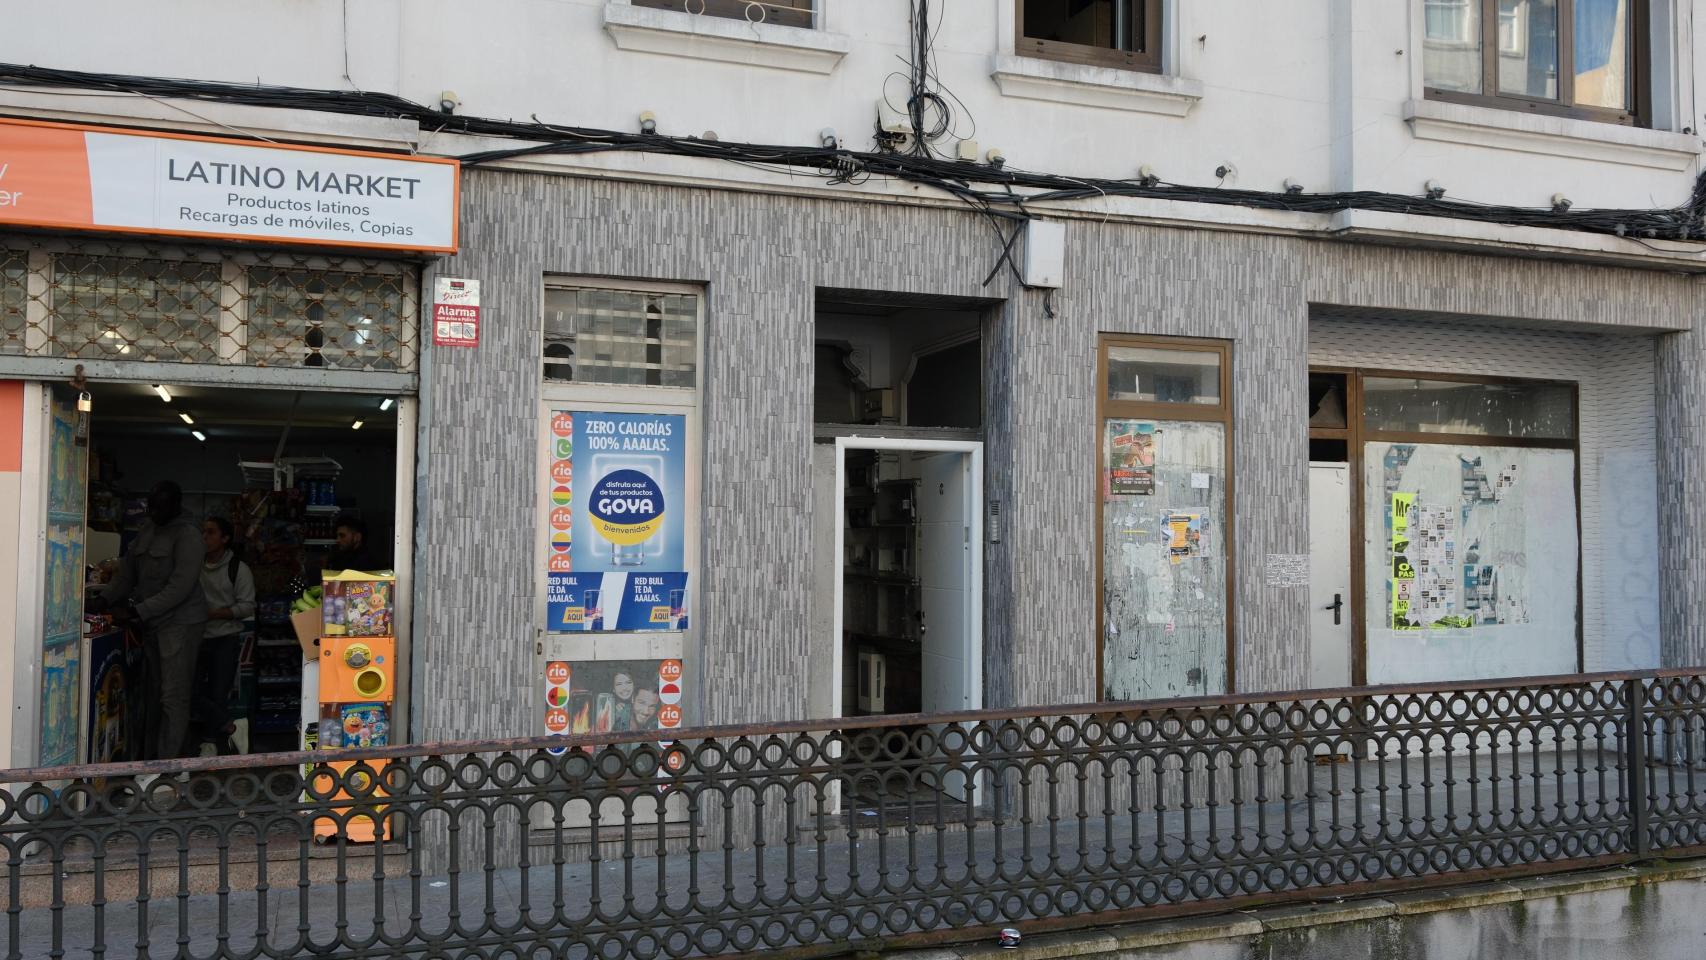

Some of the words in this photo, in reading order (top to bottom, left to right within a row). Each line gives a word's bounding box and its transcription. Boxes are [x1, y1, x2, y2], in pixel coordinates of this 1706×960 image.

[168, 158, 286, 190] LATINO
[296, 169, 421, 200] MARKET
[227, 193, 312, 212] Productos
[317, 199, 370, 216] latinos
[179, 206, 258, 227] Recargas
[263, 213, 284, 228] de
[289, 216, 355, 234] móviles,
[359, 220, 414, 237] Copias
[437, 306, 476, 317] Alarma
[554, 417, 572, 429] ria
[585, 420, 616, 434] ZERO
[618, 420, 672, 436] CALORÍAS
[588, 436, 620, 450] 100%
[622, 438, 670, 451] AAALAS.
[553, 464, 572, 476] ria
[632, 481, 647, 489] aquí
[620, 489, 653, 497] productos
[598, 498, 654, 515] GOYA
[552, 511, 571, 523] ria
[603, 523, 651, 534] bienvenidos
[551, 556, 570, 569] ria
[547, 577, 561, 585] RED
[562, 577, 578, 585] BULL
[634, 577, 648, 585] RED
[648, 577, 664, 585] BULL
[1401, 584, 1407, 592] 5
[547, 594, 574, 602] AAALAS.
[634, 594, 661, 602] AAALAS.
[549, 664, 567, 676] ria
[662, 662, 680, 674] ria
[548, 711, 567, 723] ria
[661, 707, 679, 719] ria
